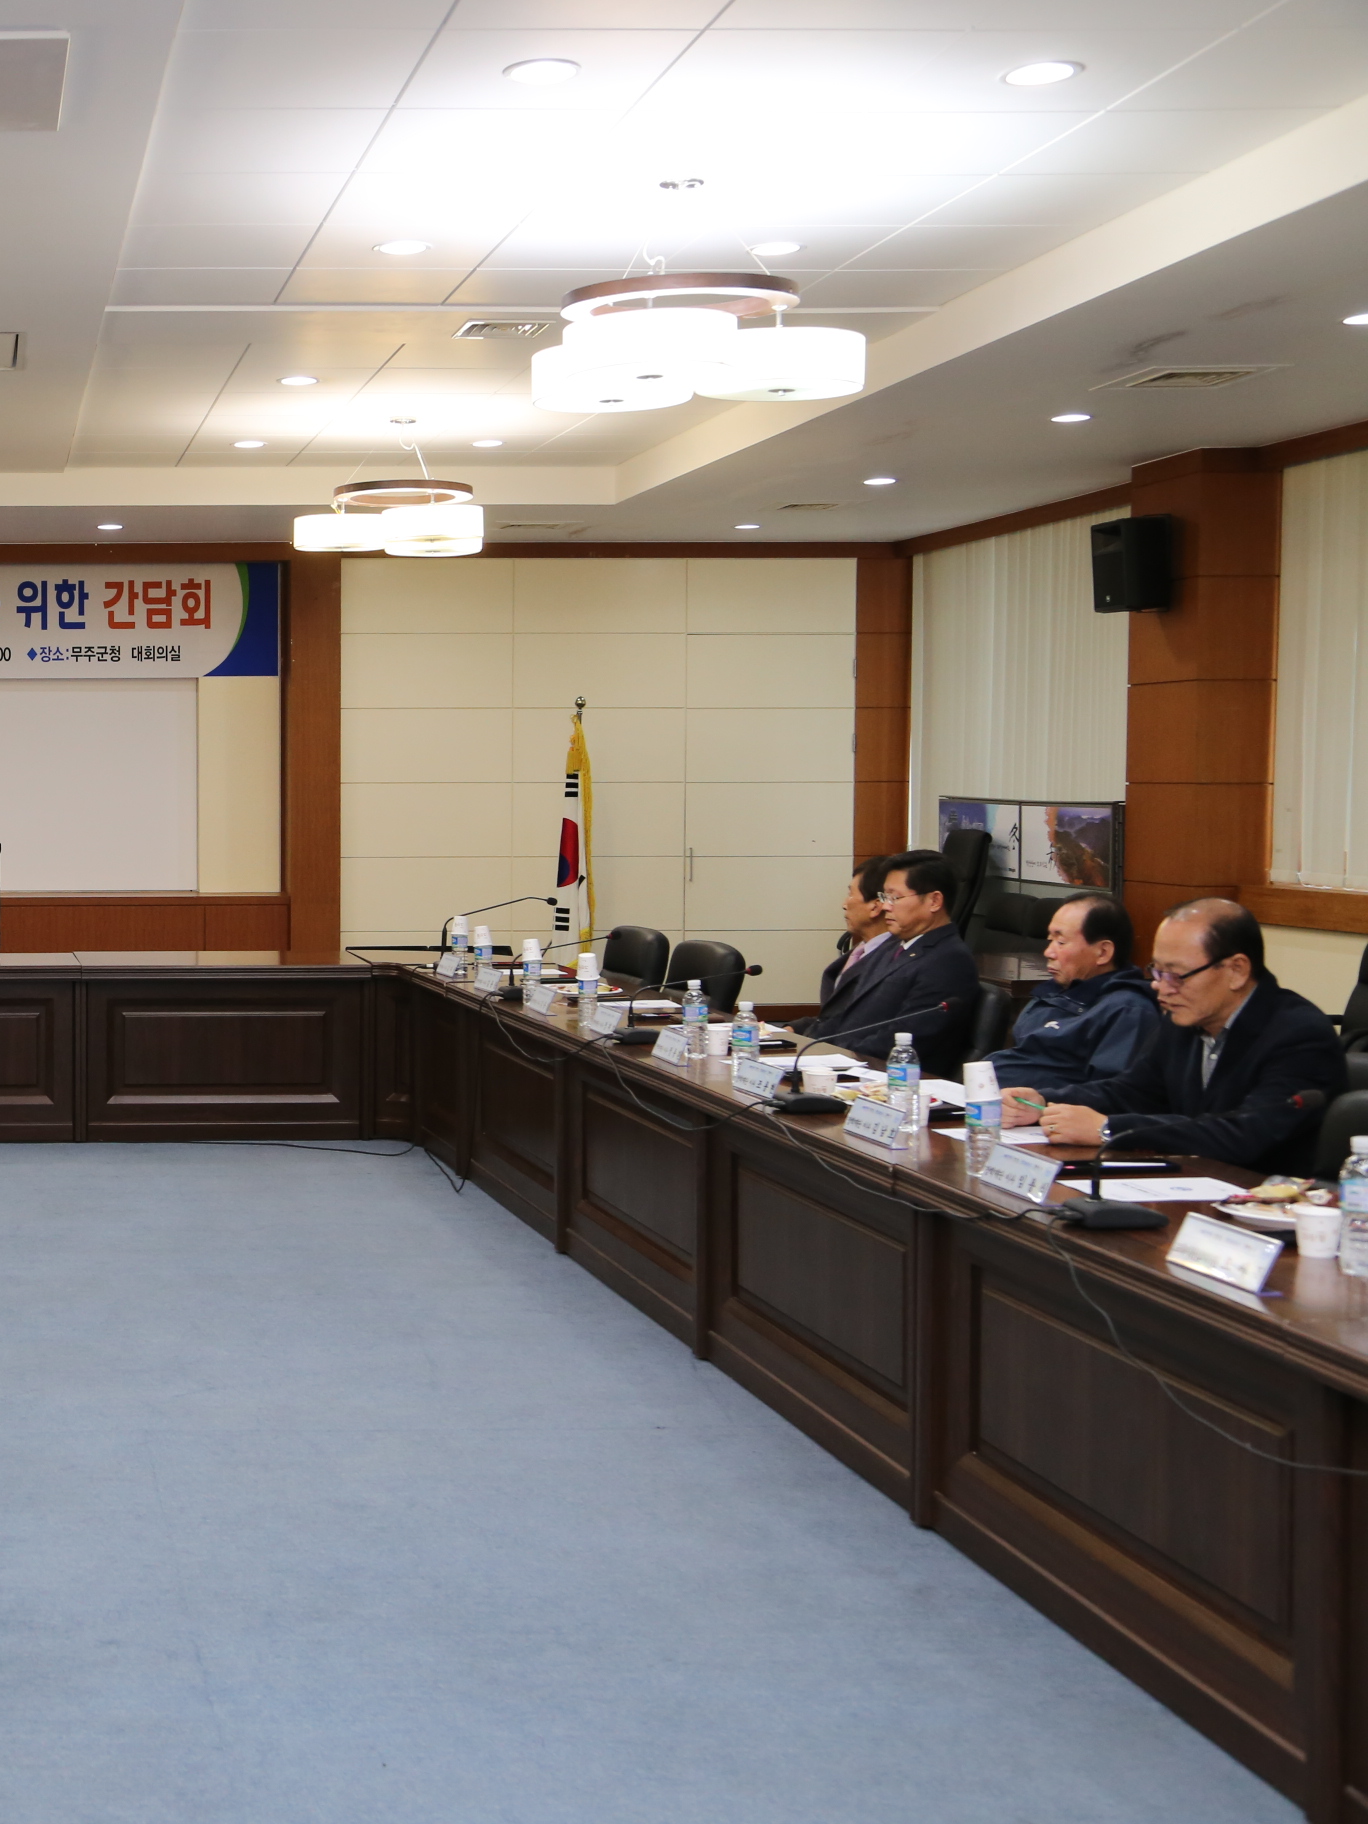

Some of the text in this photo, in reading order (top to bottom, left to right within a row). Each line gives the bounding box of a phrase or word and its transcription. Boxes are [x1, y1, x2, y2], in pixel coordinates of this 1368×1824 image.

[15, 578, 90, 631] 위한
[102, 578, 212, 631] 간담회
[131, 645, 182, 662] 대회의실
